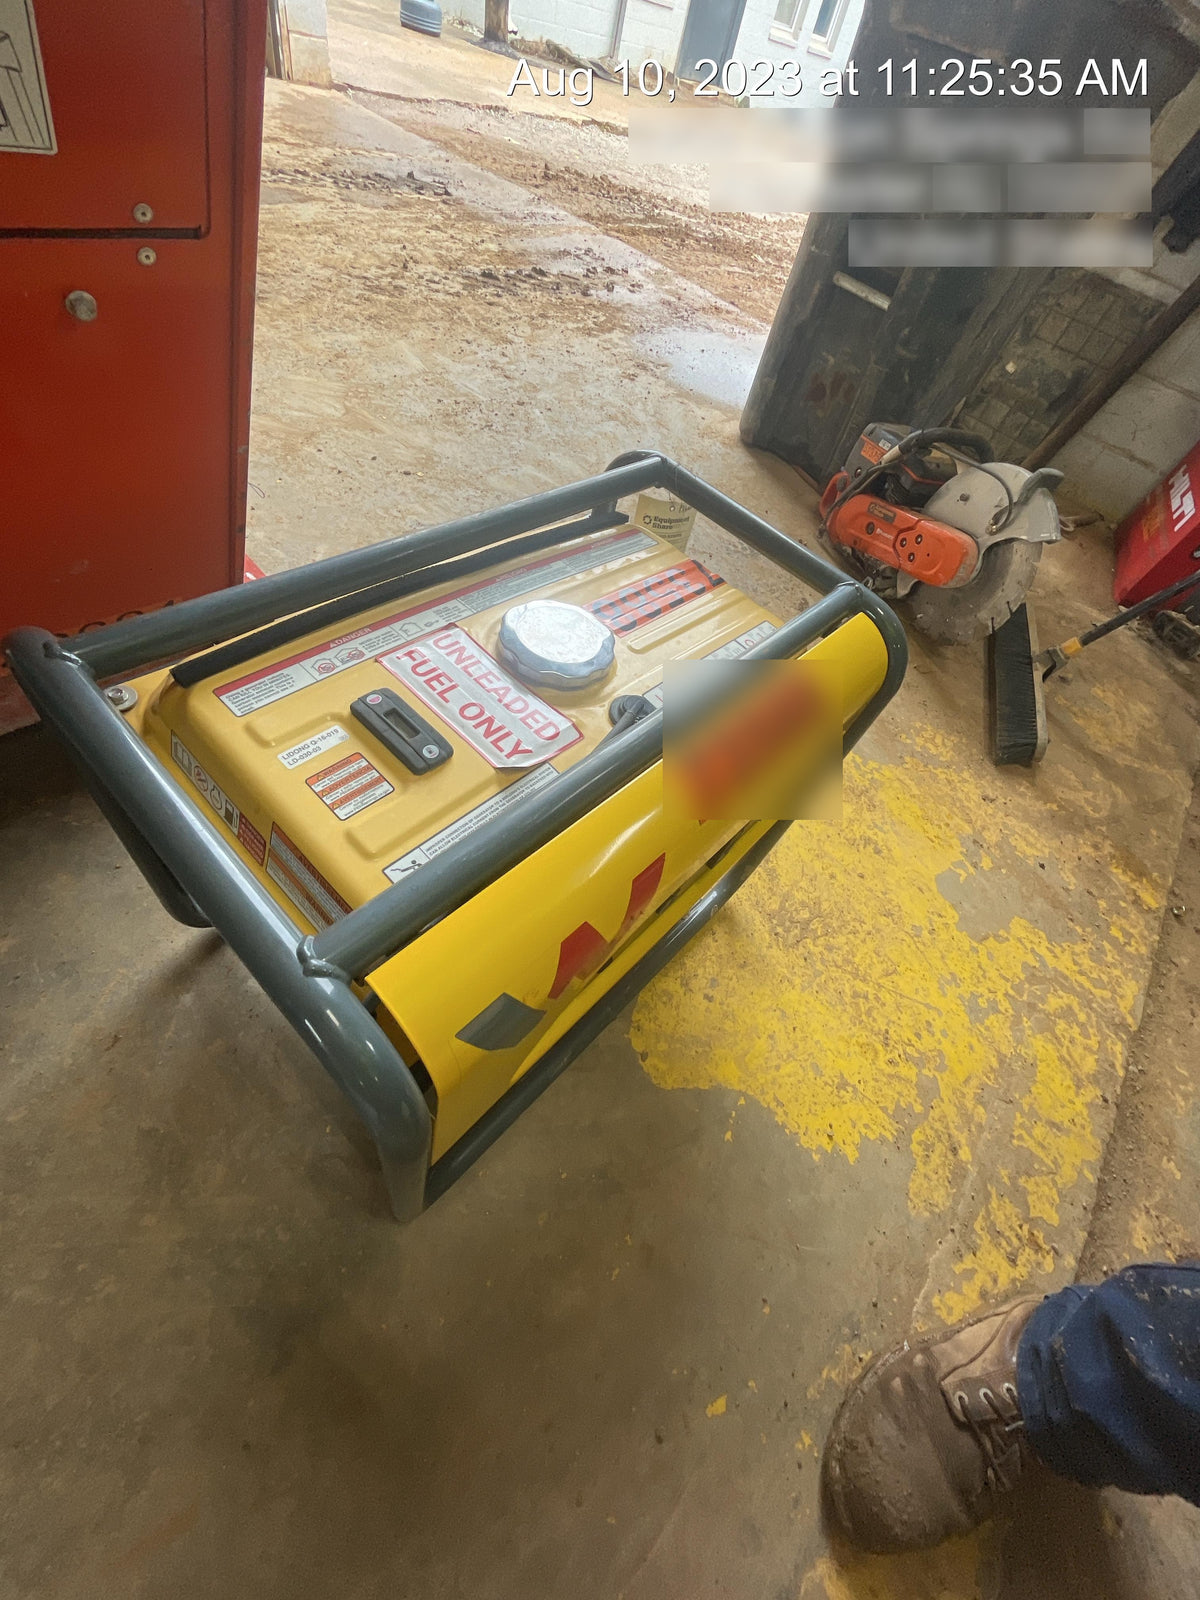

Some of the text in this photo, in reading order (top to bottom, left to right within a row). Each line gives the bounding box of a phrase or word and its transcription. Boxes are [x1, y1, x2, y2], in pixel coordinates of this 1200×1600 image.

[1169, 464, 1196, 532] HILTI
[335, 627, 372, 645] DANGER
[397, 648, 533, 760] FUEL ONLY
[432, 633, 561, 741] UNLEADED
